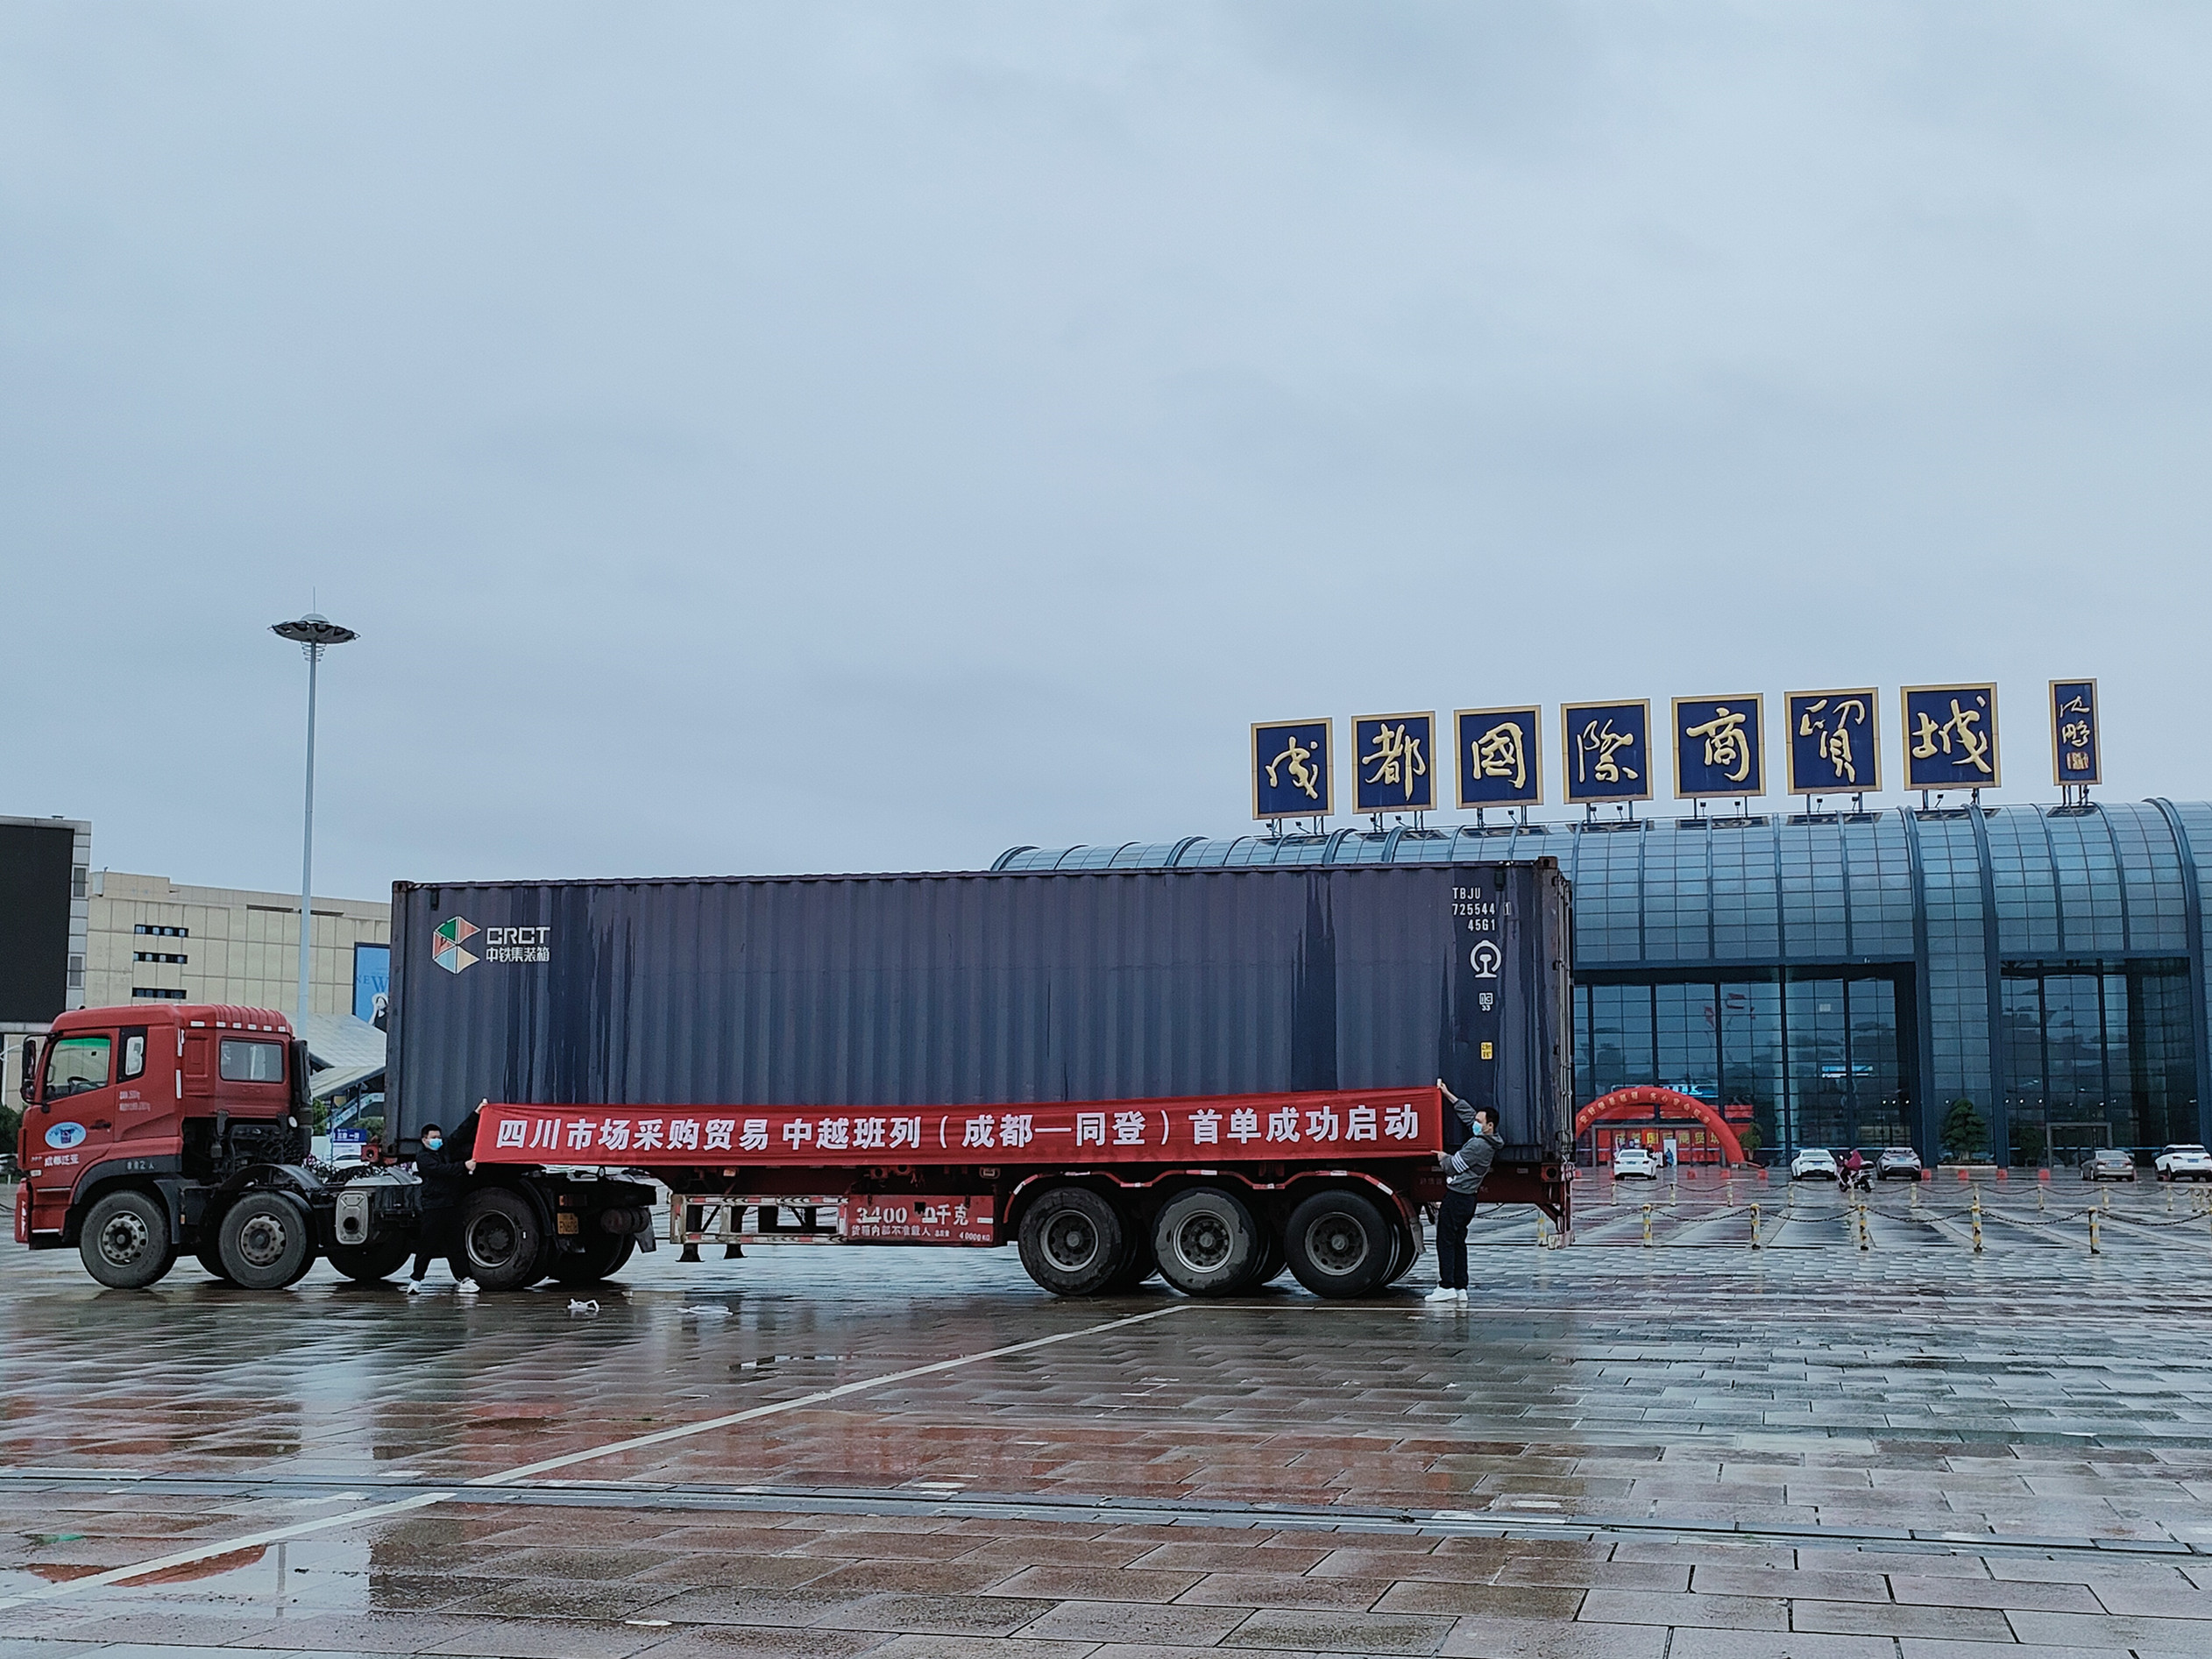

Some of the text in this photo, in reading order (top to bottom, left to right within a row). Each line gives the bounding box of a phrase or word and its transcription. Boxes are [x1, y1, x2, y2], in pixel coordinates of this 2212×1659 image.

[1452, 887, 1481, 900] TBJU
[1451, 903, 1496, 916] 725544
[1467, 918, 1495, 932] 45G1
[486, 926, 551, 945] CRCT
[486, 946, 550, 962] 中铁集装箱
[496, 1118, 769, 1152] 四川市场采购贸易
